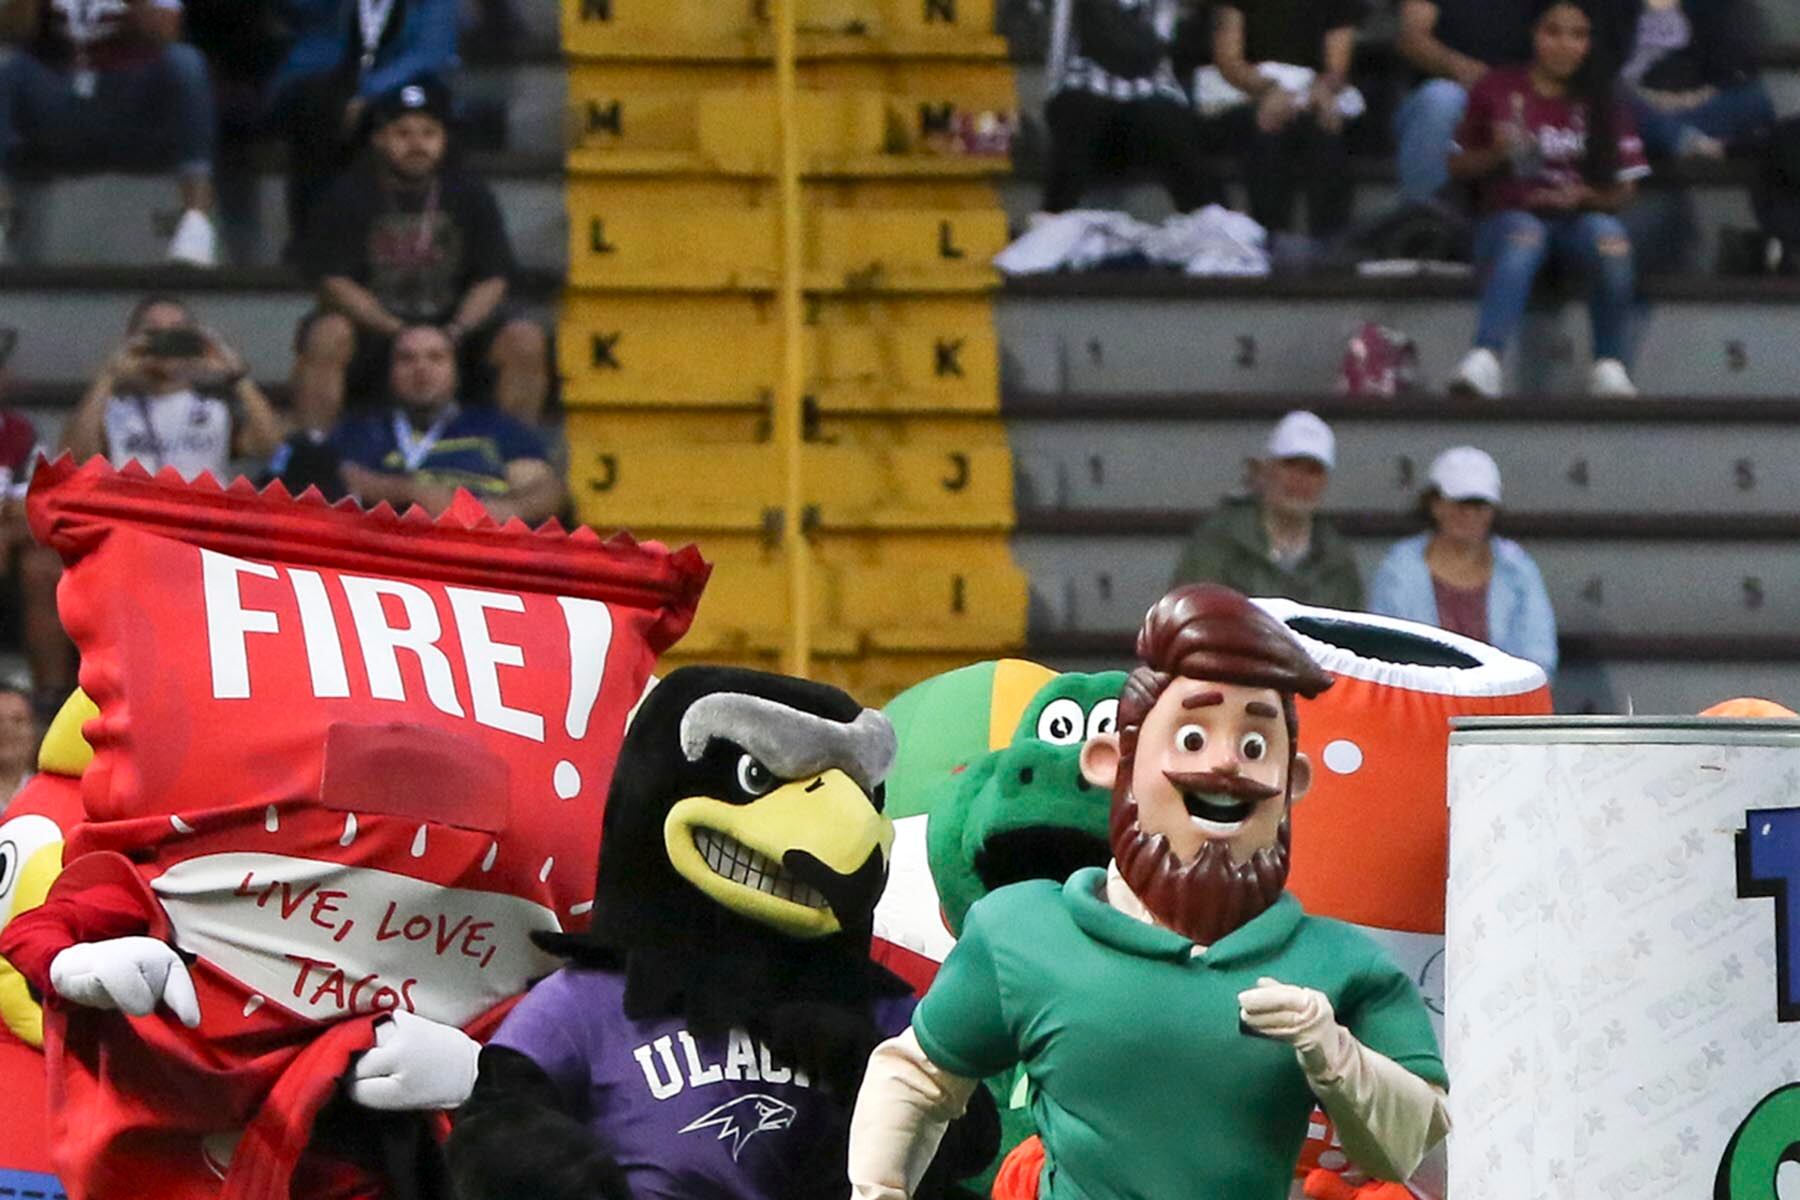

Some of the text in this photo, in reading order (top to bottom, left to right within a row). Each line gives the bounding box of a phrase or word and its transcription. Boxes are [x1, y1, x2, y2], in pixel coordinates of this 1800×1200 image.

[587, 99, 620, 134] M
[589, 214, 616, 253] L
[937, 218, 964, 259] L
[590, 331, 619, 369] K
[933, 336, 963, 377] K
[1235, 336, 1257, 368] 2
[1727, 338, 1748, 372] 5
[588, 453, 618, 492] J
[941, 451, 970, 492] J
[1734, 457, 1757, 491] 5
[199, 545, 617, 800] FIRE!
[234, 871, 497, 968] LIVE, LOVE,
[285, 954, 418, 1013] TACOS
